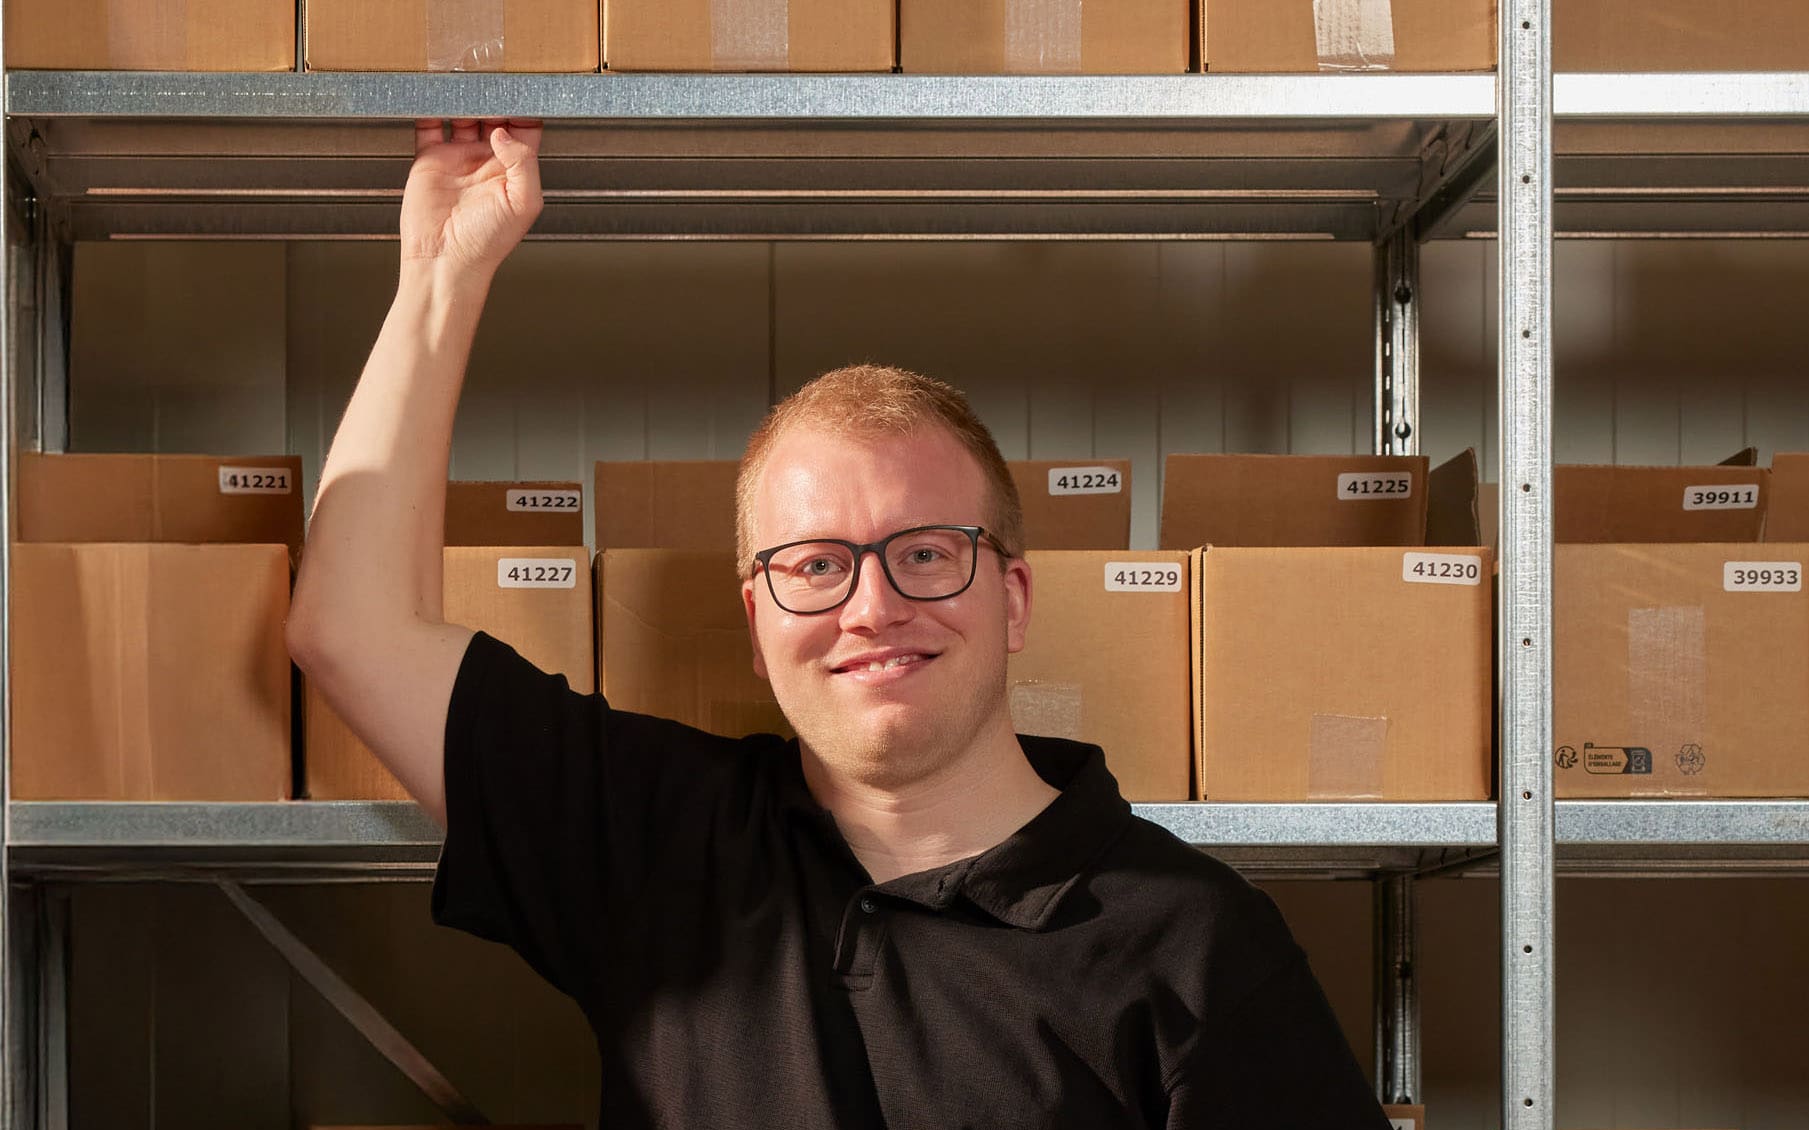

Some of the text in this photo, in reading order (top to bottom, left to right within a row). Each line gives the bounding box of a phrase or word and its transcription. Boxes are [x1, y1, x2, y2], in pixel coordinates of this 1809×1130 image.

[228, 474, 288, 489] 41221
[1057, 474, 1118, 489] 41224
[1347, 480, 1408, 494] 41225
[516, 495, 577, 508] 41222
[1692, 491, 1753, 505] 39911
[508, 567, 572, 582] 41227
[1412, 561, 1478, 579] 41230
[1733, 569, 1798, 585] 39933
[1114, 570, 1178, 586] 41229
